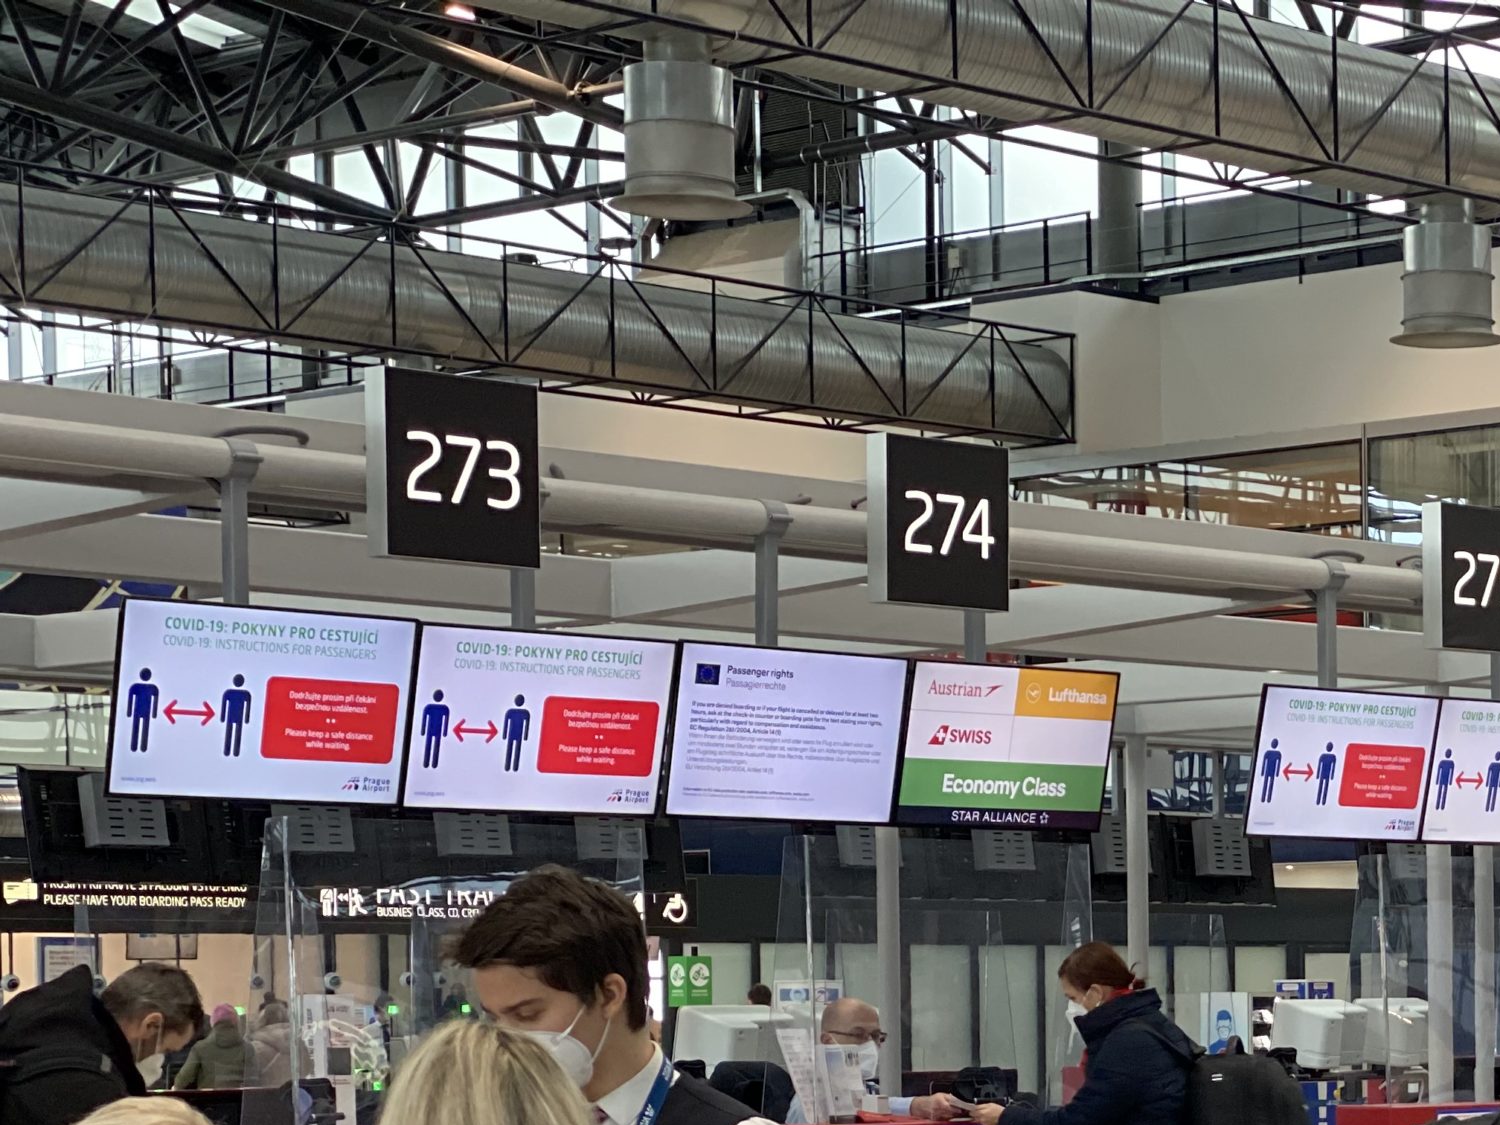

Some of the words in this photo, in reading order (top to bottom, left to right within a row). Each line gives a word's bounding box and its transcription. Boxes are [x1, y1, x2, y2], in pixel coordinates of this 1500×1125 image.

[406, 430, 521, 510] 273
[904, 490, 995, 560] 274
[165, 616, 229, 633] COVID-19:
[232, 621, 286, 638] POKYNY
[290, 626, 315, 640] PRO
[163, 634, 212, 648] COVID-19:
[215, 637, 290, 654] INSTRUCTIONS
[292, 643, 311, 655] FOR
[314, 644, 377, 660] PASSENGERS
[456, 641, 512, 657] COVID-19:
[515, 646, 563, 660] POKYNY
[565, 648, 588, 662] PRO
[454, 658, 498, 671] COVID-19:
[500, 660, 565, 675] INSTRUCTIONS
[567, 665, 585, 676] FOR
[586, 667, 640, 680] PASSENGERS
[727, 665, 770, 678] Passenger
[770, 668, 794, 680] rights
[726, 678, 786, 691] Passagierrechte
[928, 680, 982, 698] Austrian
[1048, 687, 1107, 705] Lufthansa
[1289, 699, 1327, 711] COVID-19:
[1328, 702, 1361, 713] POKYNY
[1363, 704, 1378, 714] PRO
[285, 728, 307, 739] Please
[308, 729, 324, 740] keep
[331, 730, 345, 740] safe
[345, 731, 373, 741] distance
[949, 729, 992, 745] SWISS
[306, 739, 324, 749] while
[559, 744, 578, 754] Please
[579, 745, 593, 755] keep
[362, 784, 390, 793] Airport
[363, 777, 390, 787] Prague
[942, 773, 1020, 800] Economy
[1021, 776, 1066, 797] Class
[625, 796, 649, 804] Airport
[626, 789, 650, 798] Prague
[951, 810, 980, 822] STAR
[982, 811, 1036, 824] ALLIANCE
[43, 894, 80, 905] PLEASE
[82, 895, 109, 906] HAVE
[110, 895, 137, 907] YOUR
[139, 896, 188, 907] BOARDING
[190, 896, 213, 908] PASS
[215, 896, 246, 908] READY
[377, 907, 416, 917] BUSINES
